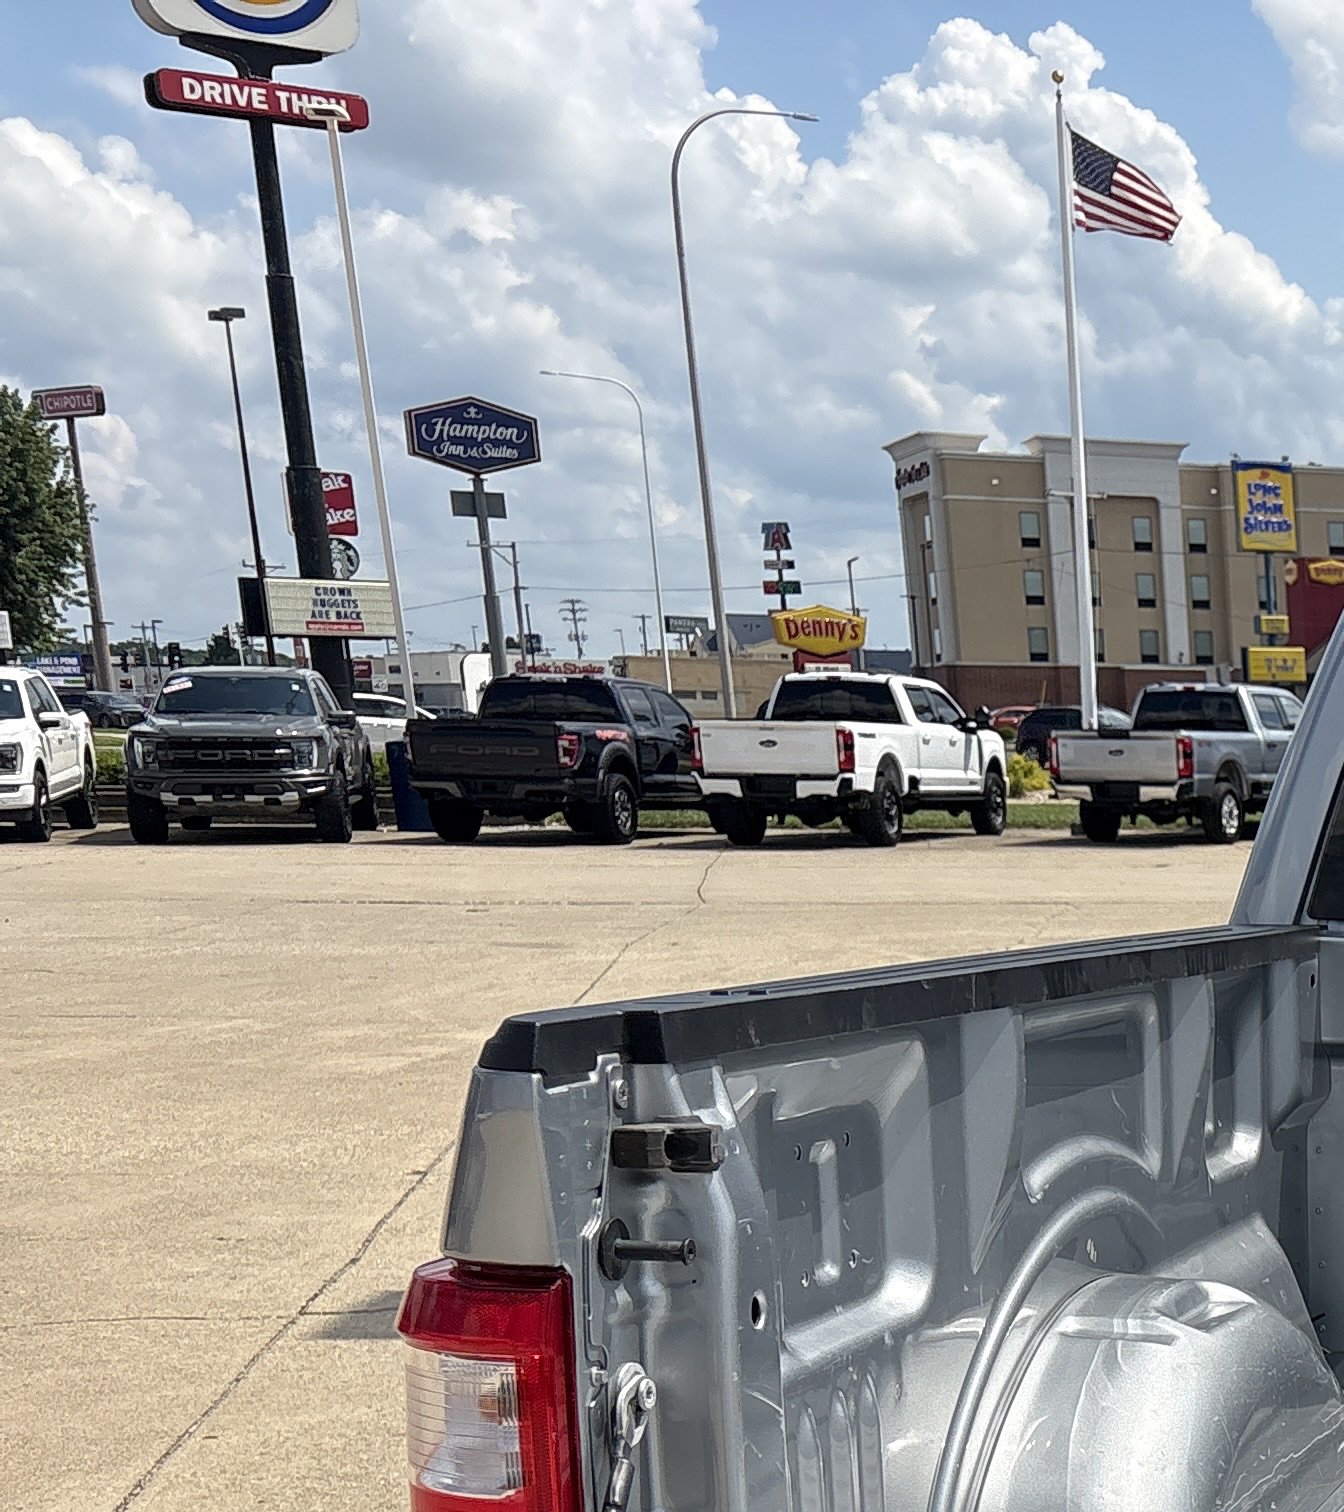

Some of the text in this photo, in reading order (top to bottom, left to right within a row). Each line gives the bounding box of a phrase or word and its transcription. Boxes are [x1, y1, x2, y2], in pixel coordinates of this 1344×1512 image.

[181, 76, 269, 110] DRIVE
[46, 393, 93, 410] CHIPOTLE
[421, 417, 527, 443] Hampton
[433, 441, 471, 457] Inn
[479, 443, 519, 459] Suites
[1249, 498, 1284, 515] JOHN
[784, 617, 859, 642] Denny's
